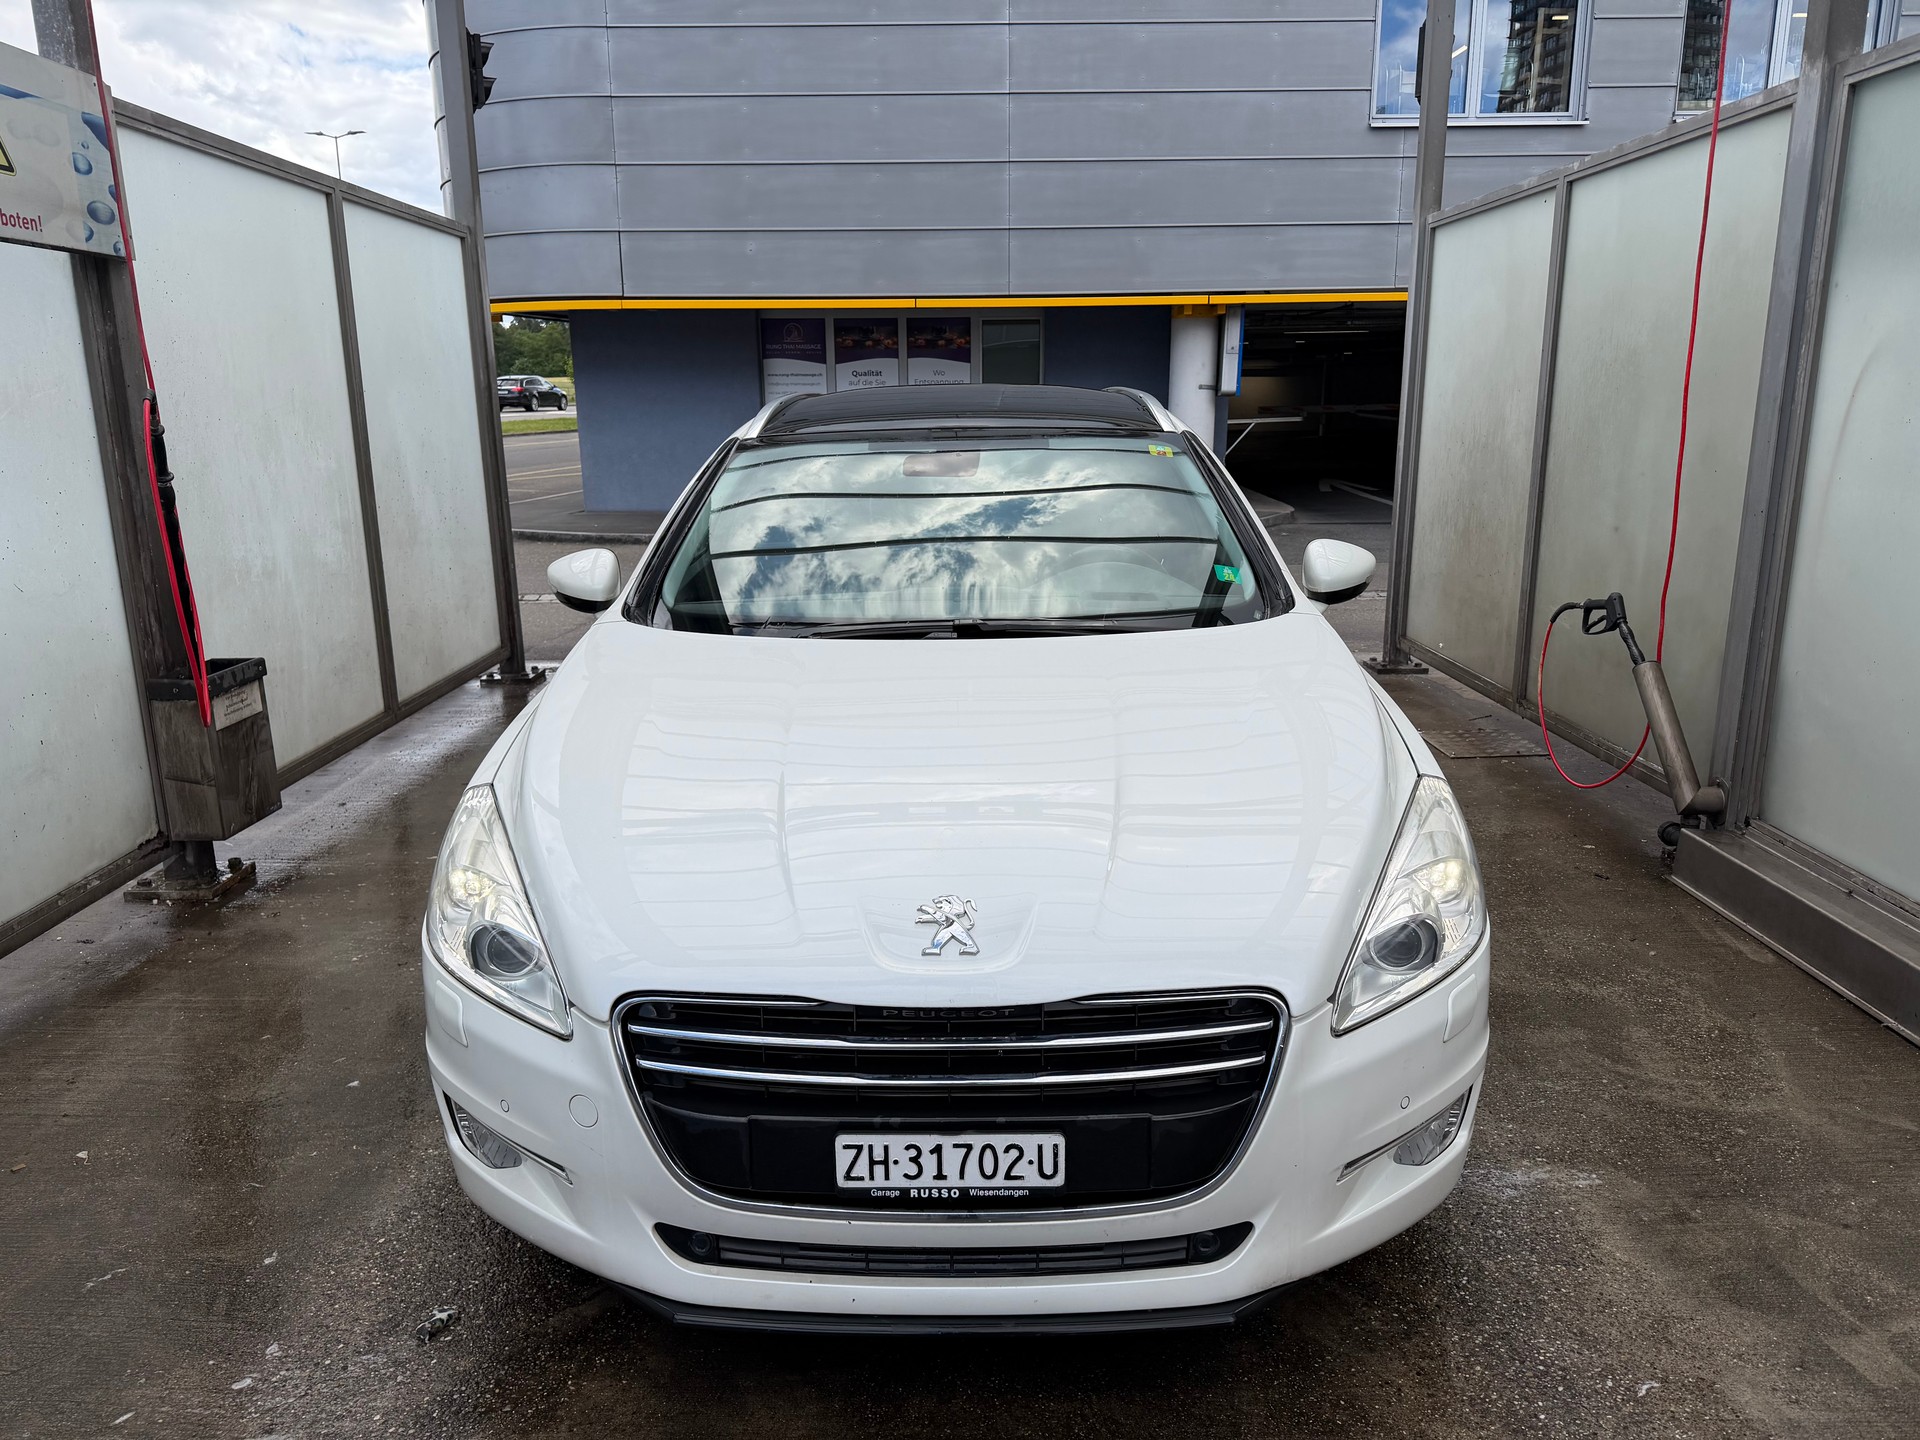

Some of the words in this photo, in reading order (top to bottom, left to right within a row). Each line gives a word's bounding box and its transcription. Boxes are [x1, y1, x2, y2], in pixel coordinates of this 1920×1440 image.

[882, 1008, 1015, 1018] PEUGEOT
[870, 1188, 900, 1197] Garage
[910, 1188, 960, 1198] RUSSO
[969, 1188, 1029, 1197] Wiesendangen
